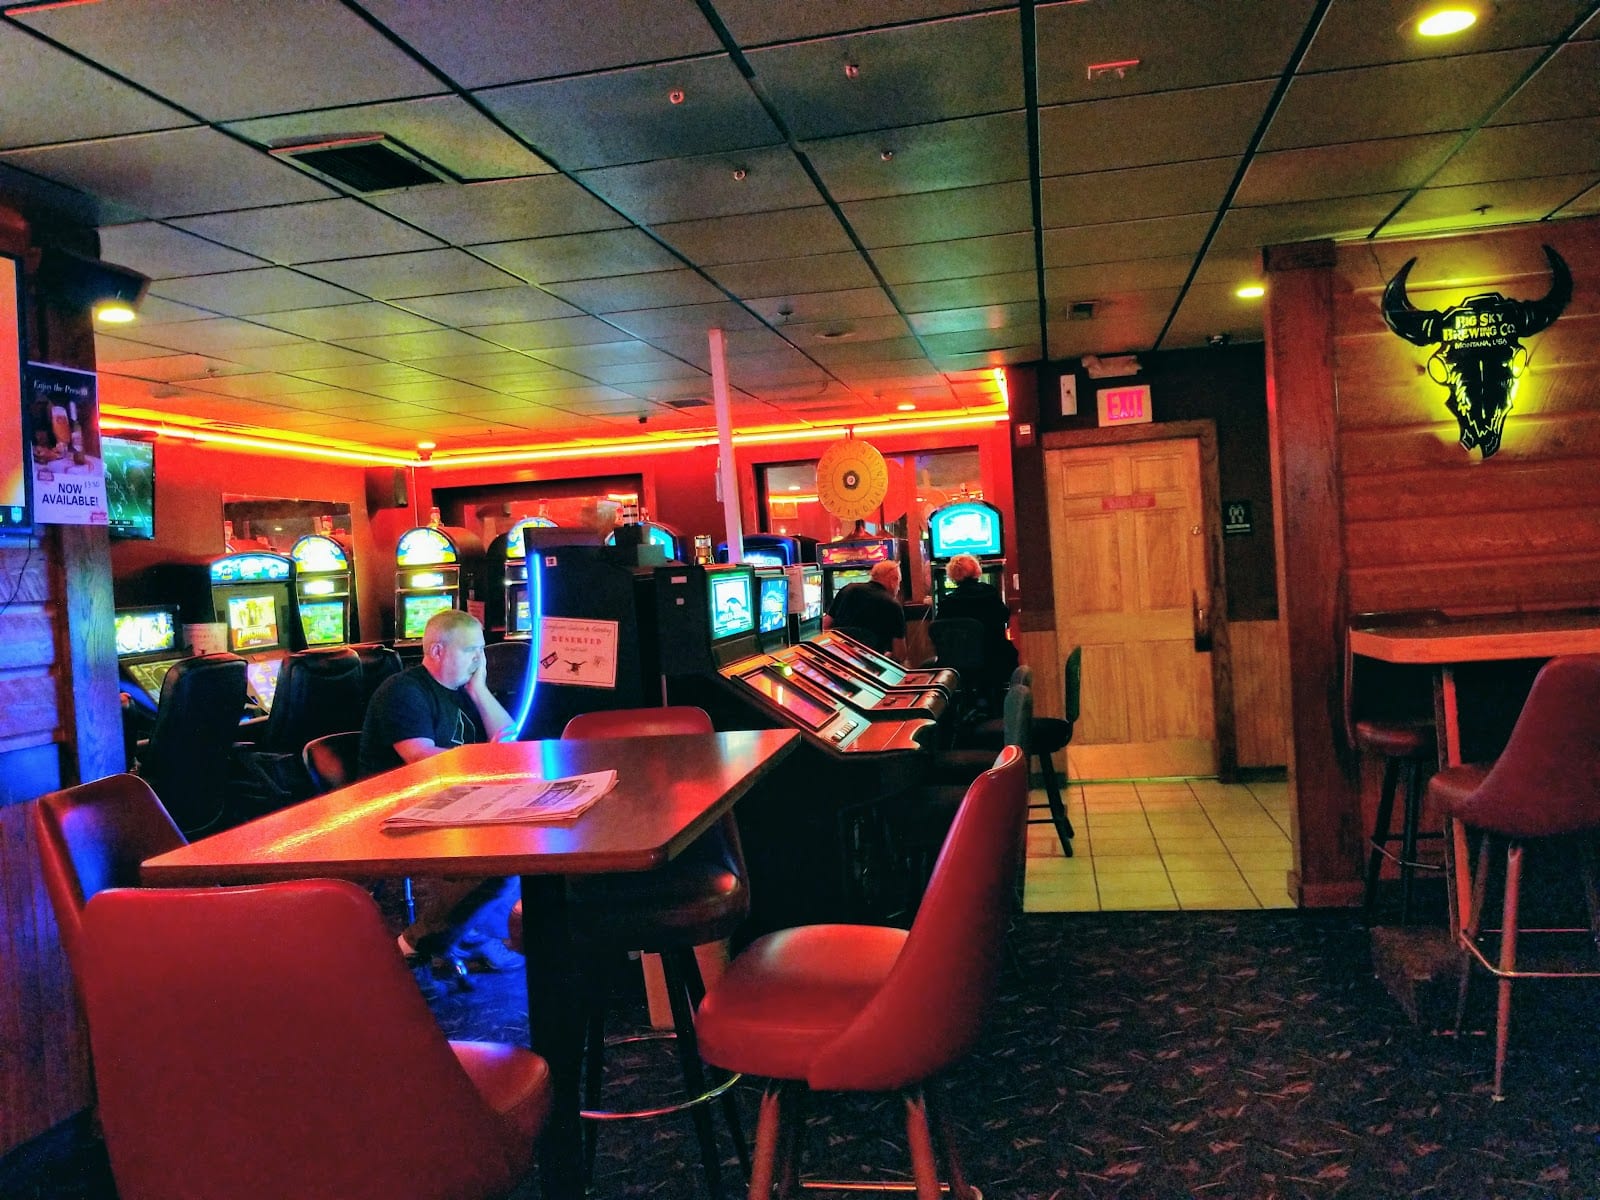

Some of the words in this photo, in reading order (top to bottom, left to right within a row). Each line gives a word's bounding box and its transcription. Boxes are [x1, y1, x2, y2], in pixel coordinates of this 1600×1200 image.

[1455, 315, 1477, 329] BIG
[1479, 313, 1504, 326] SKY
[1443, 326, 1497, 341] BREWING
[1492, 337, 1508, 347] USA
[53, 382, 65, 394] the
[1107, 390, 1144, 420] EXIT
[58, 483, 83, 494] NOW
[41, 493, 99, 507] AVAILABLE!
[552, 636, 602, 644] RESERVED
